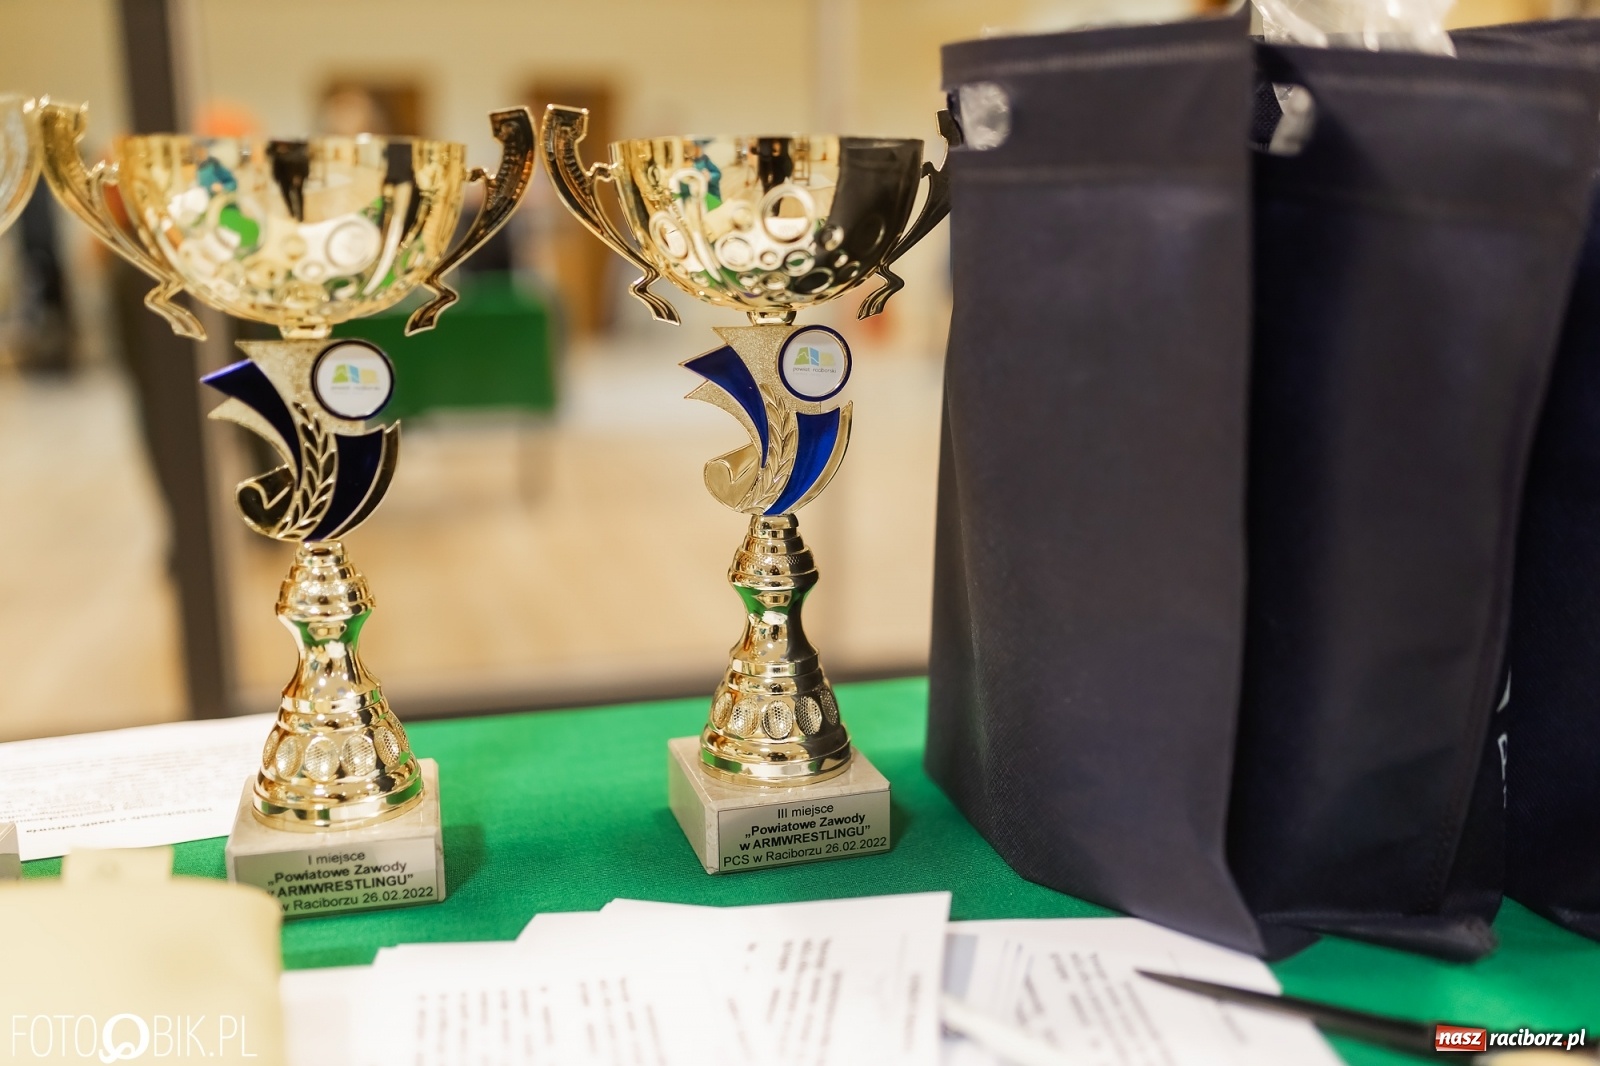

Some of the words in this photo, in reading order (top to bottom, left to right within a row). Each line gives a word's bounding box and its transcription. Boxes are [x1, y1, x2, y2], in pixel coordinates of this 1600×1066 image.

[777, 808, 788, 819] III
[791, 803, 834, 818] miejsce
[745, 819, 816, 838] „Powiatowe
[819, 813, 866, 827] Zawody
[739, 842, 751, 851] w
[752, 825, 871, 850] ARMWRESTLINGU”
[316, 851, 366, 865] miejsce
[723, 854, 750, 868] PCS
[753, 854, 763, 863] w
[766, 847, 822, 862] Raciborzu
[825, 836, 887, 854] 26.02.2022
[354, 860, 408, 875] Zawody
[293, 896, 359, 910] Raciborzu
[363, 886, 434, 904] 26.02.2022
